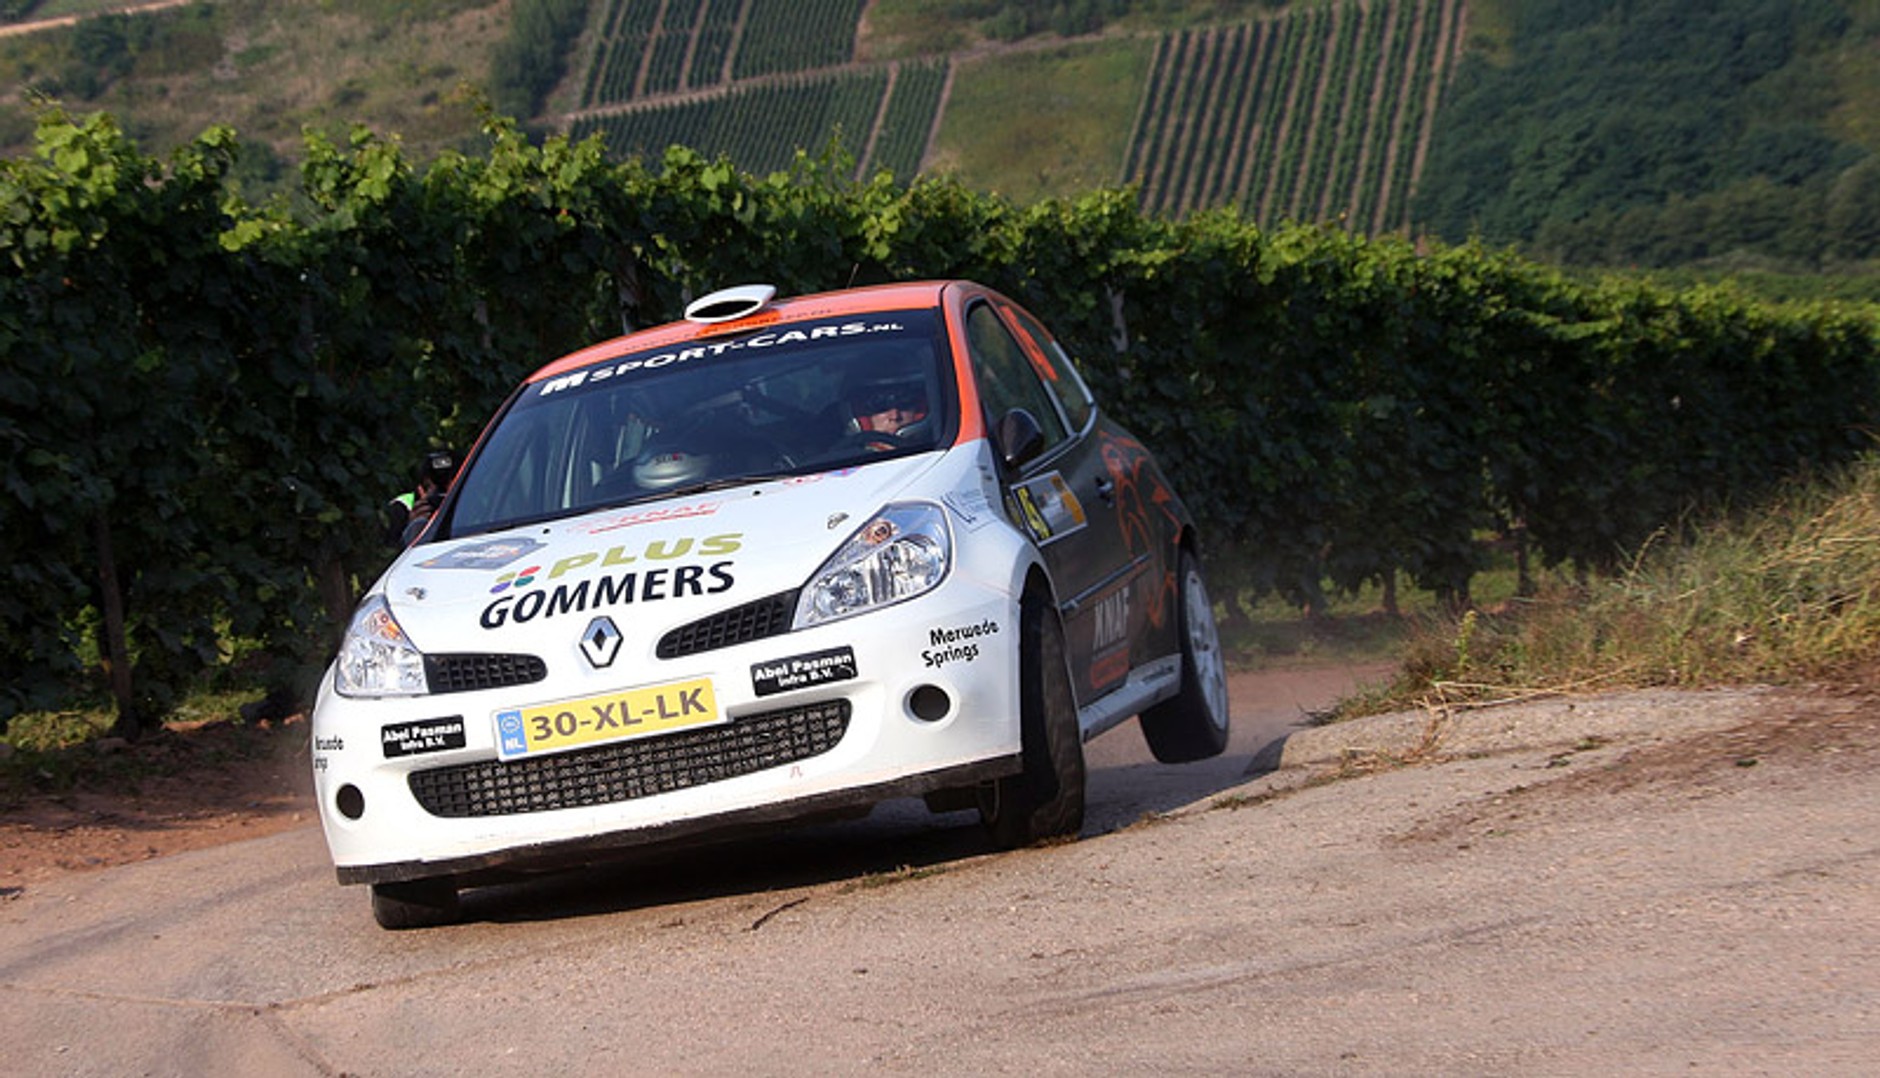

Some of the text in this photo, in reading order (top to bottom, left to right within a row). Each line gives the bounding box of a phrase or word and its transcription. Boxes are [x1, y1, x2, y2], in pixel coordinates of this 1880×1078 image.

[547, 532, 745, 580] PLUS
[479, 561, 735, 630] GOMMERS
[929, 619, 999, 646] Merwede
[754, 653, 852, 682] Abel Pasman
[921, 644, 979, 668] Springs
[530, 687, 710, 742] 30-XL-LK
[383, 723, 462, 743] Abel Pasman
[504, 738, 524, 751] NL
